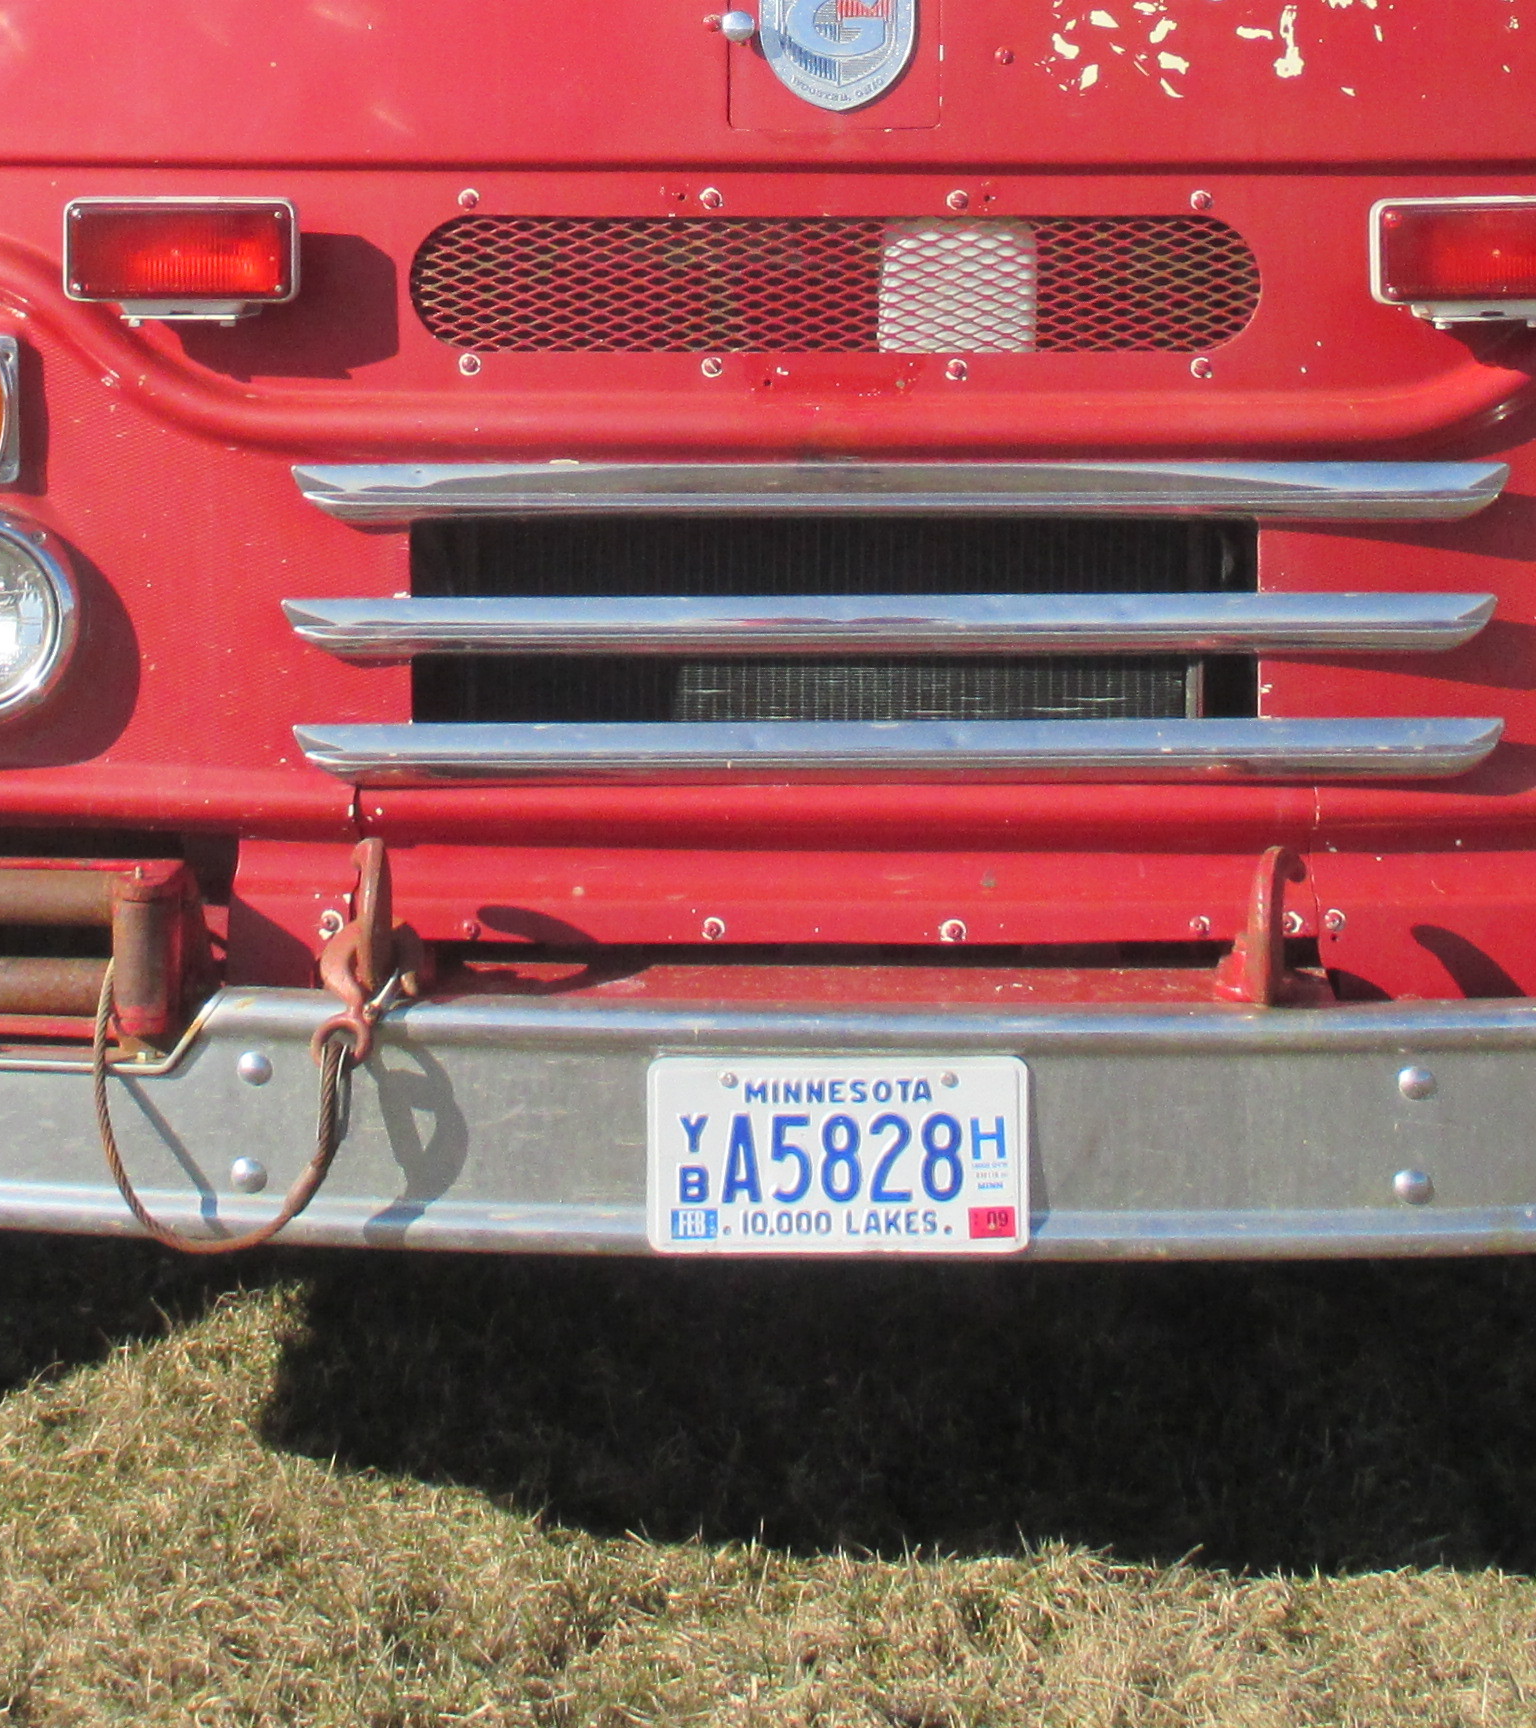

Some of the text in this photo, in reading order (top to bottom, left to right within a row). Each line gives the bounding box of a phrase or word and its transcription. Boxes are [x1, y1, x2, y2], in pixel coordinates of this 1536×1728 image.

[744, 1078, 932, 1104] MINNESOTA
[970, 1116, 1007, 1159] H
[722, 1112, 964, 1204] A5828
[679, 1210, 706, 1237] FEB
[846, 1210, 938, 1235] LAKES
